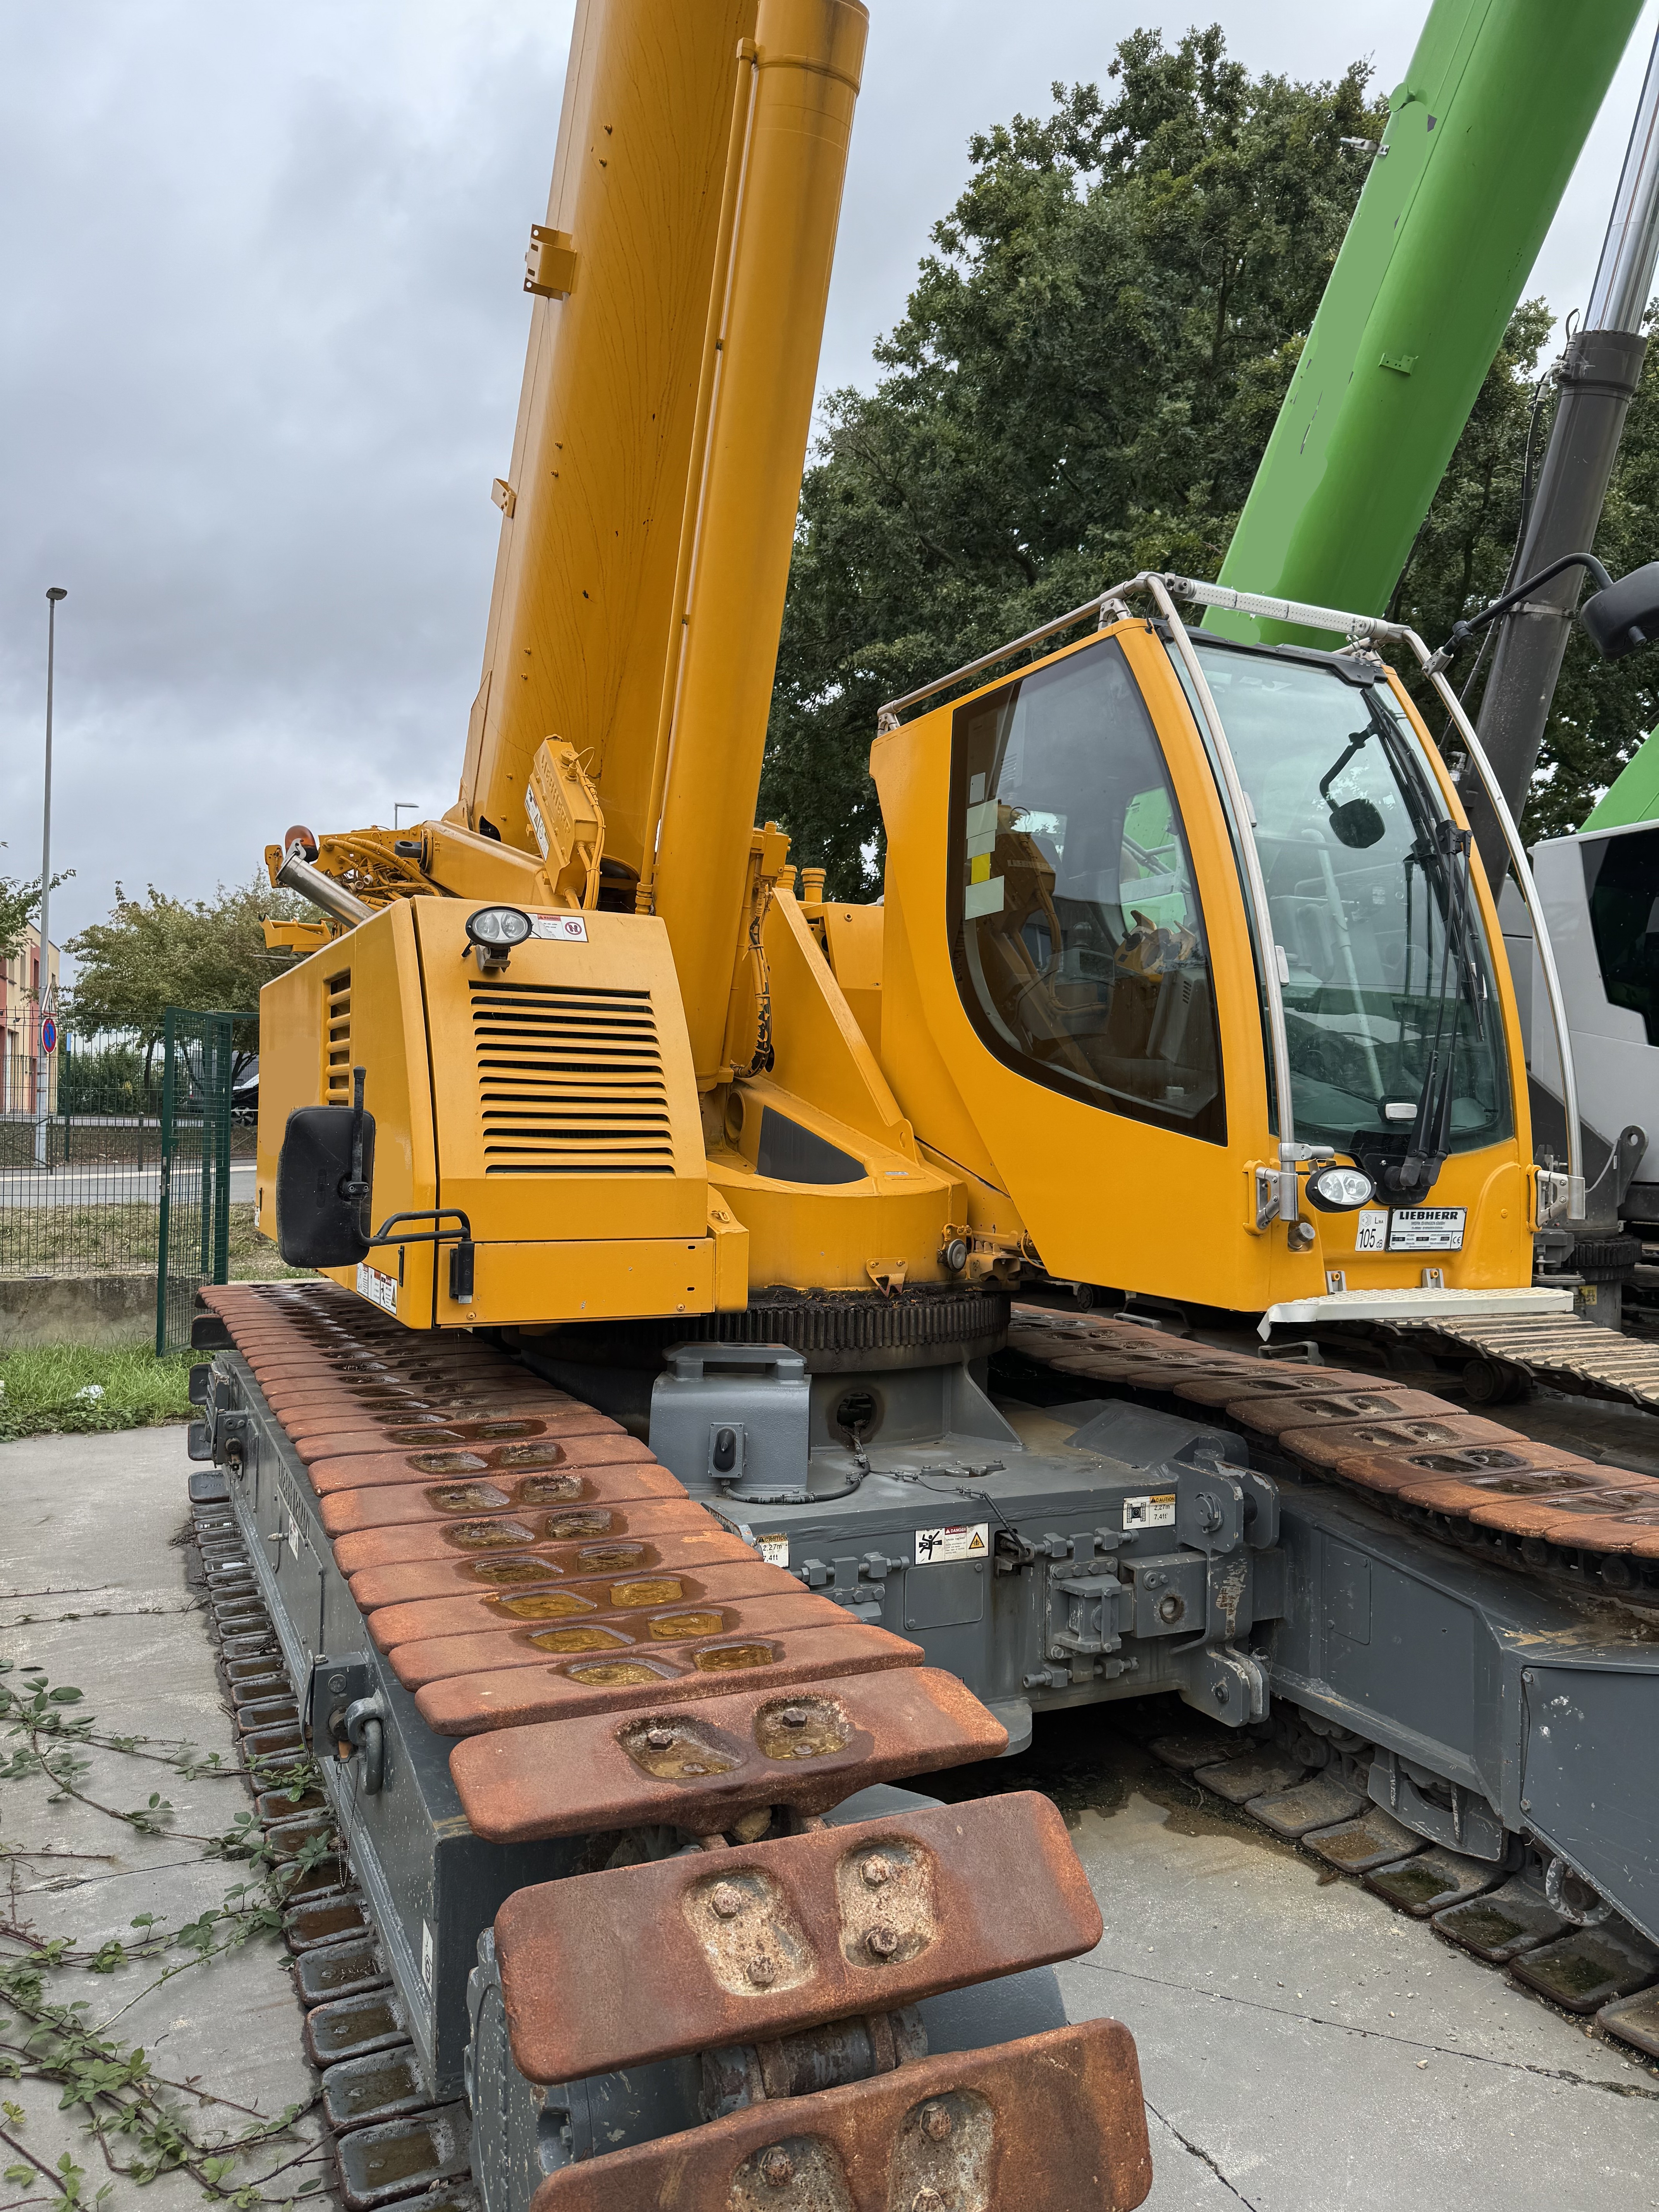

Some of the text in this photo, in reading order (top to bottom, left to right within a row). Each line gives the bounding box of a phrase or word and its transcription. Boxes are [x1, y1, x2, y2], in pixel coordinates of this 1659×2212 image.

[1399, 1211, 1458, 1220] LIEBHERR
[1359, 1229, 1376, 1248] 105
[1376, 1240, 1383, 1248] dB
